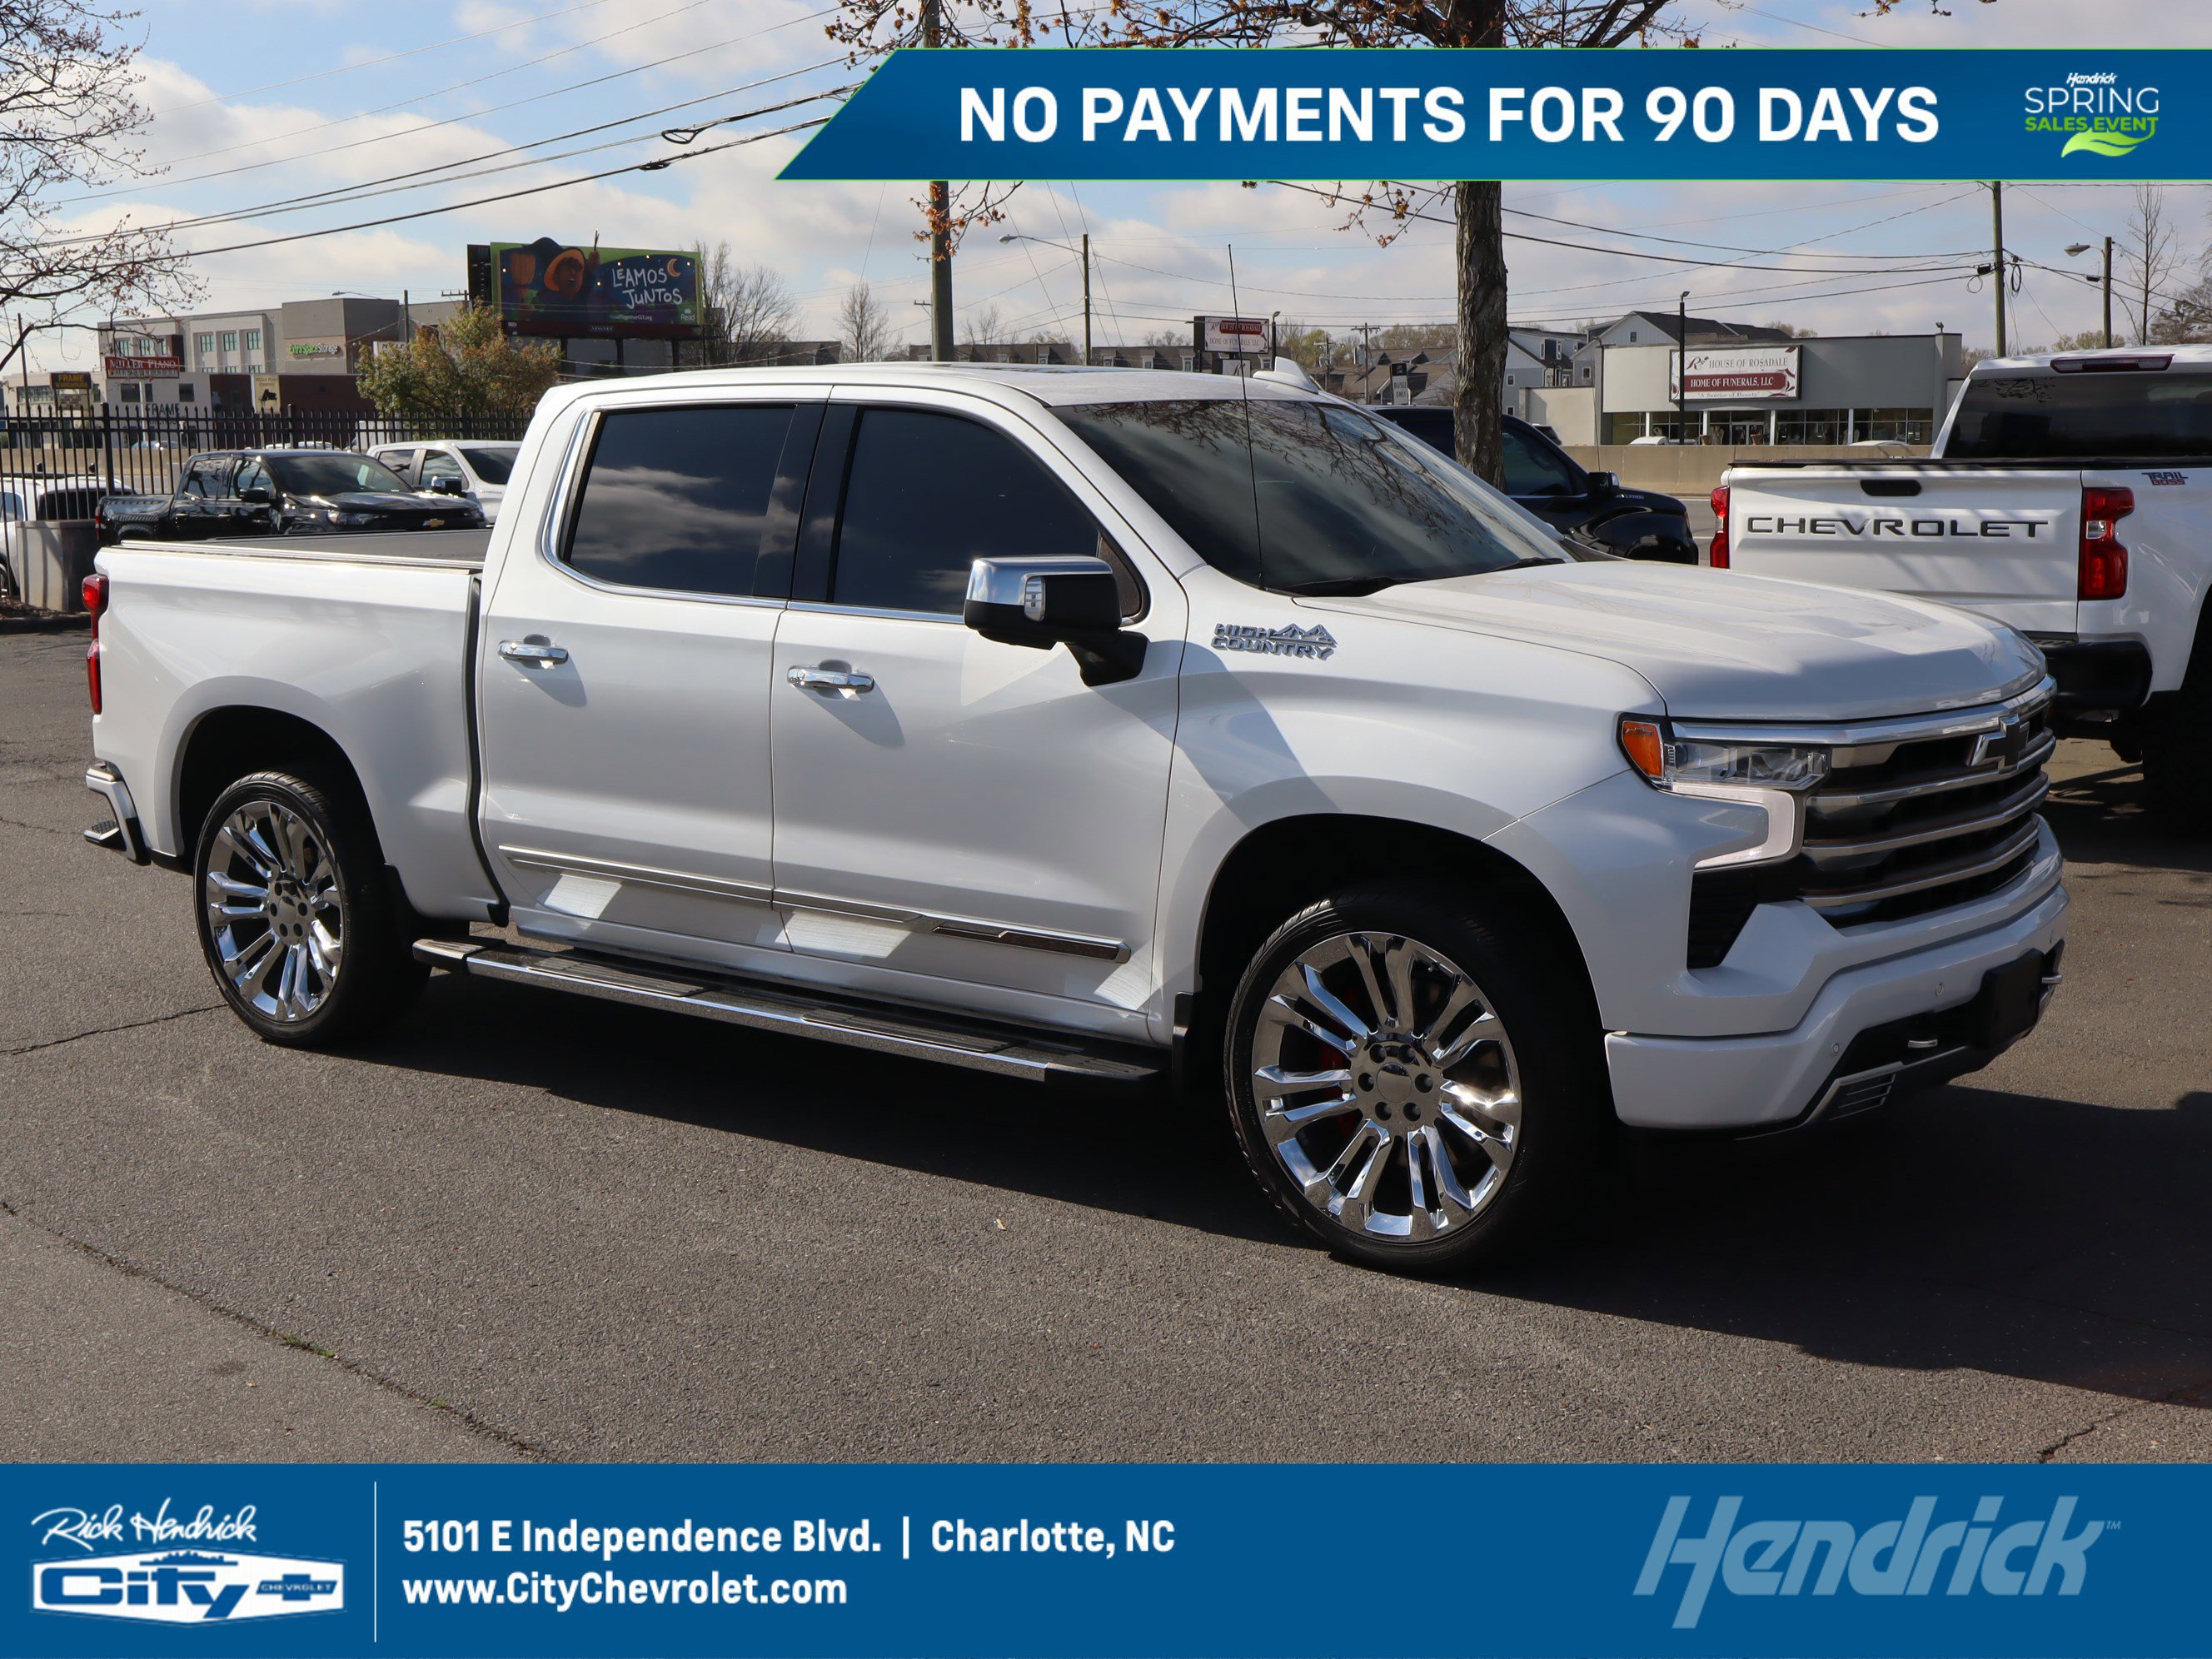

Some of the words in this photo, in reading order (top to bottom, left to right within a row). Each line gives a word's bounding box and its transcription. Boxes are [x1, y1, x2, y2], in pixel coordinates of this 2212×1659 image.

[612, 267, 667, 287] LEAMOS
[110, 359, 144, 369] MILLER
[147, 359, 176, 369] PIANO
[1709, 359, 1733, 368] HOUSE
[1736, 358, 1746, 367] OF
[1749, 357, 1788, 367] ROSADALE
[1691, 378, 1710, 387] HOME
[1711, 378, 1721, 387] OF
[1723, 376, 1759, 387] FUNERALS,
[1761, 376, 1774, 386] LLC
[2141, 471, 2189, 481] TRAIL
[1747, 516, 2050, 539] CHEVROLET
[1214, 623, 1278, 640] HIGH
[1210, 636, 1334, 660] COUNTRY
